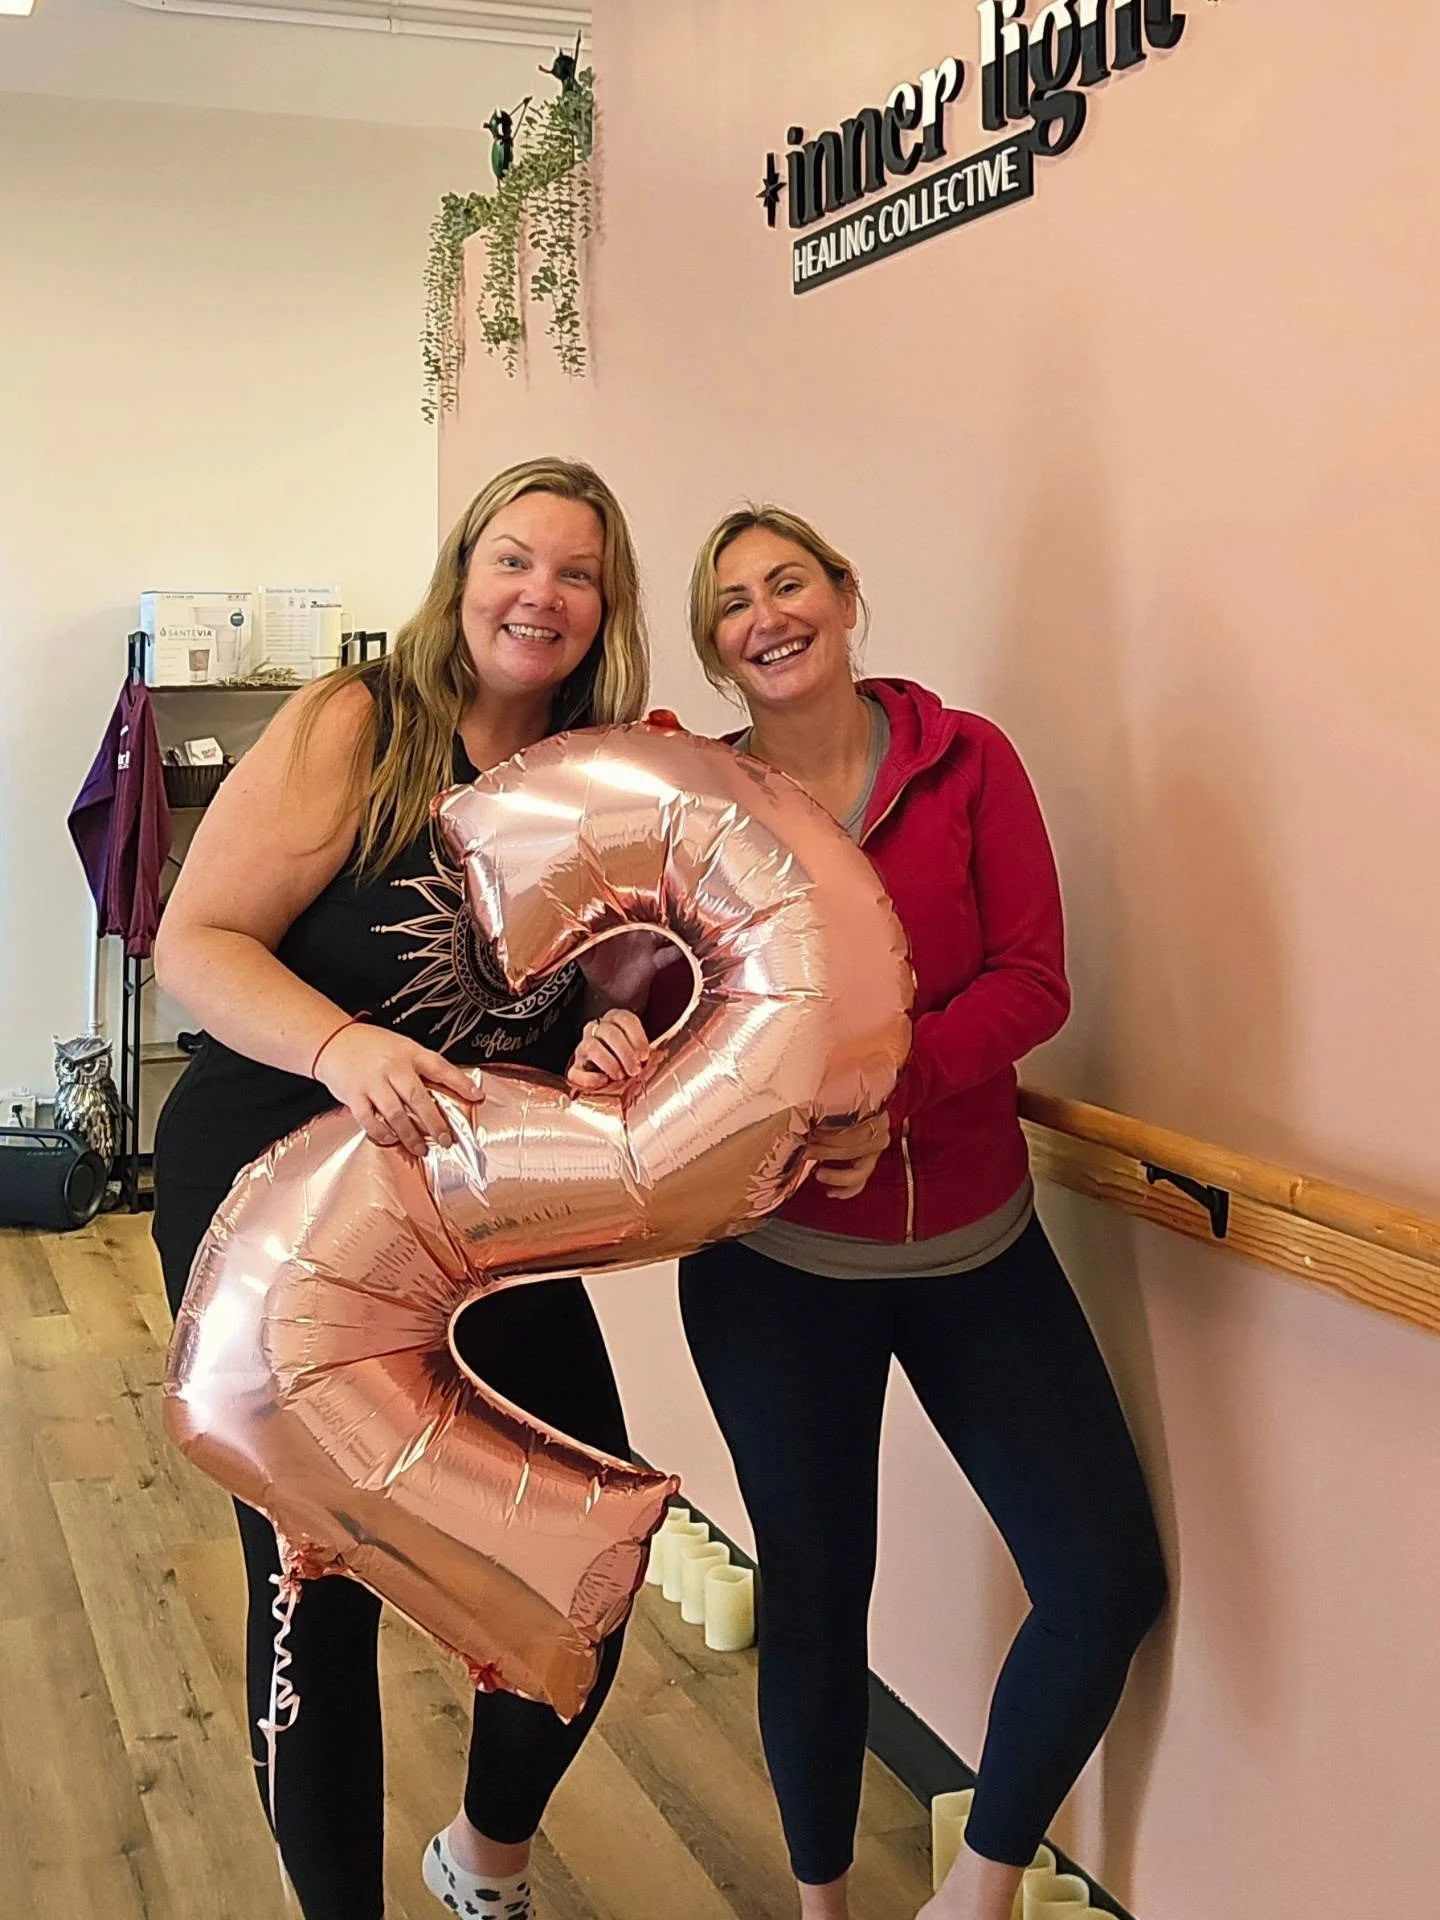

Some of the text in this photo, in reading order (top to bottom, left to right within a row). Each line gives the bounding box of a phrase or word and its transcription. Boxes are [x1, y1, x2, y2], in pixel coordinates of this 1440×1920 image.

[787, 57, 964, 228] inner
[793, 146, 1019, 282] HEALING COLLECTIVE
[471, 1027, 522, 1058] soften
